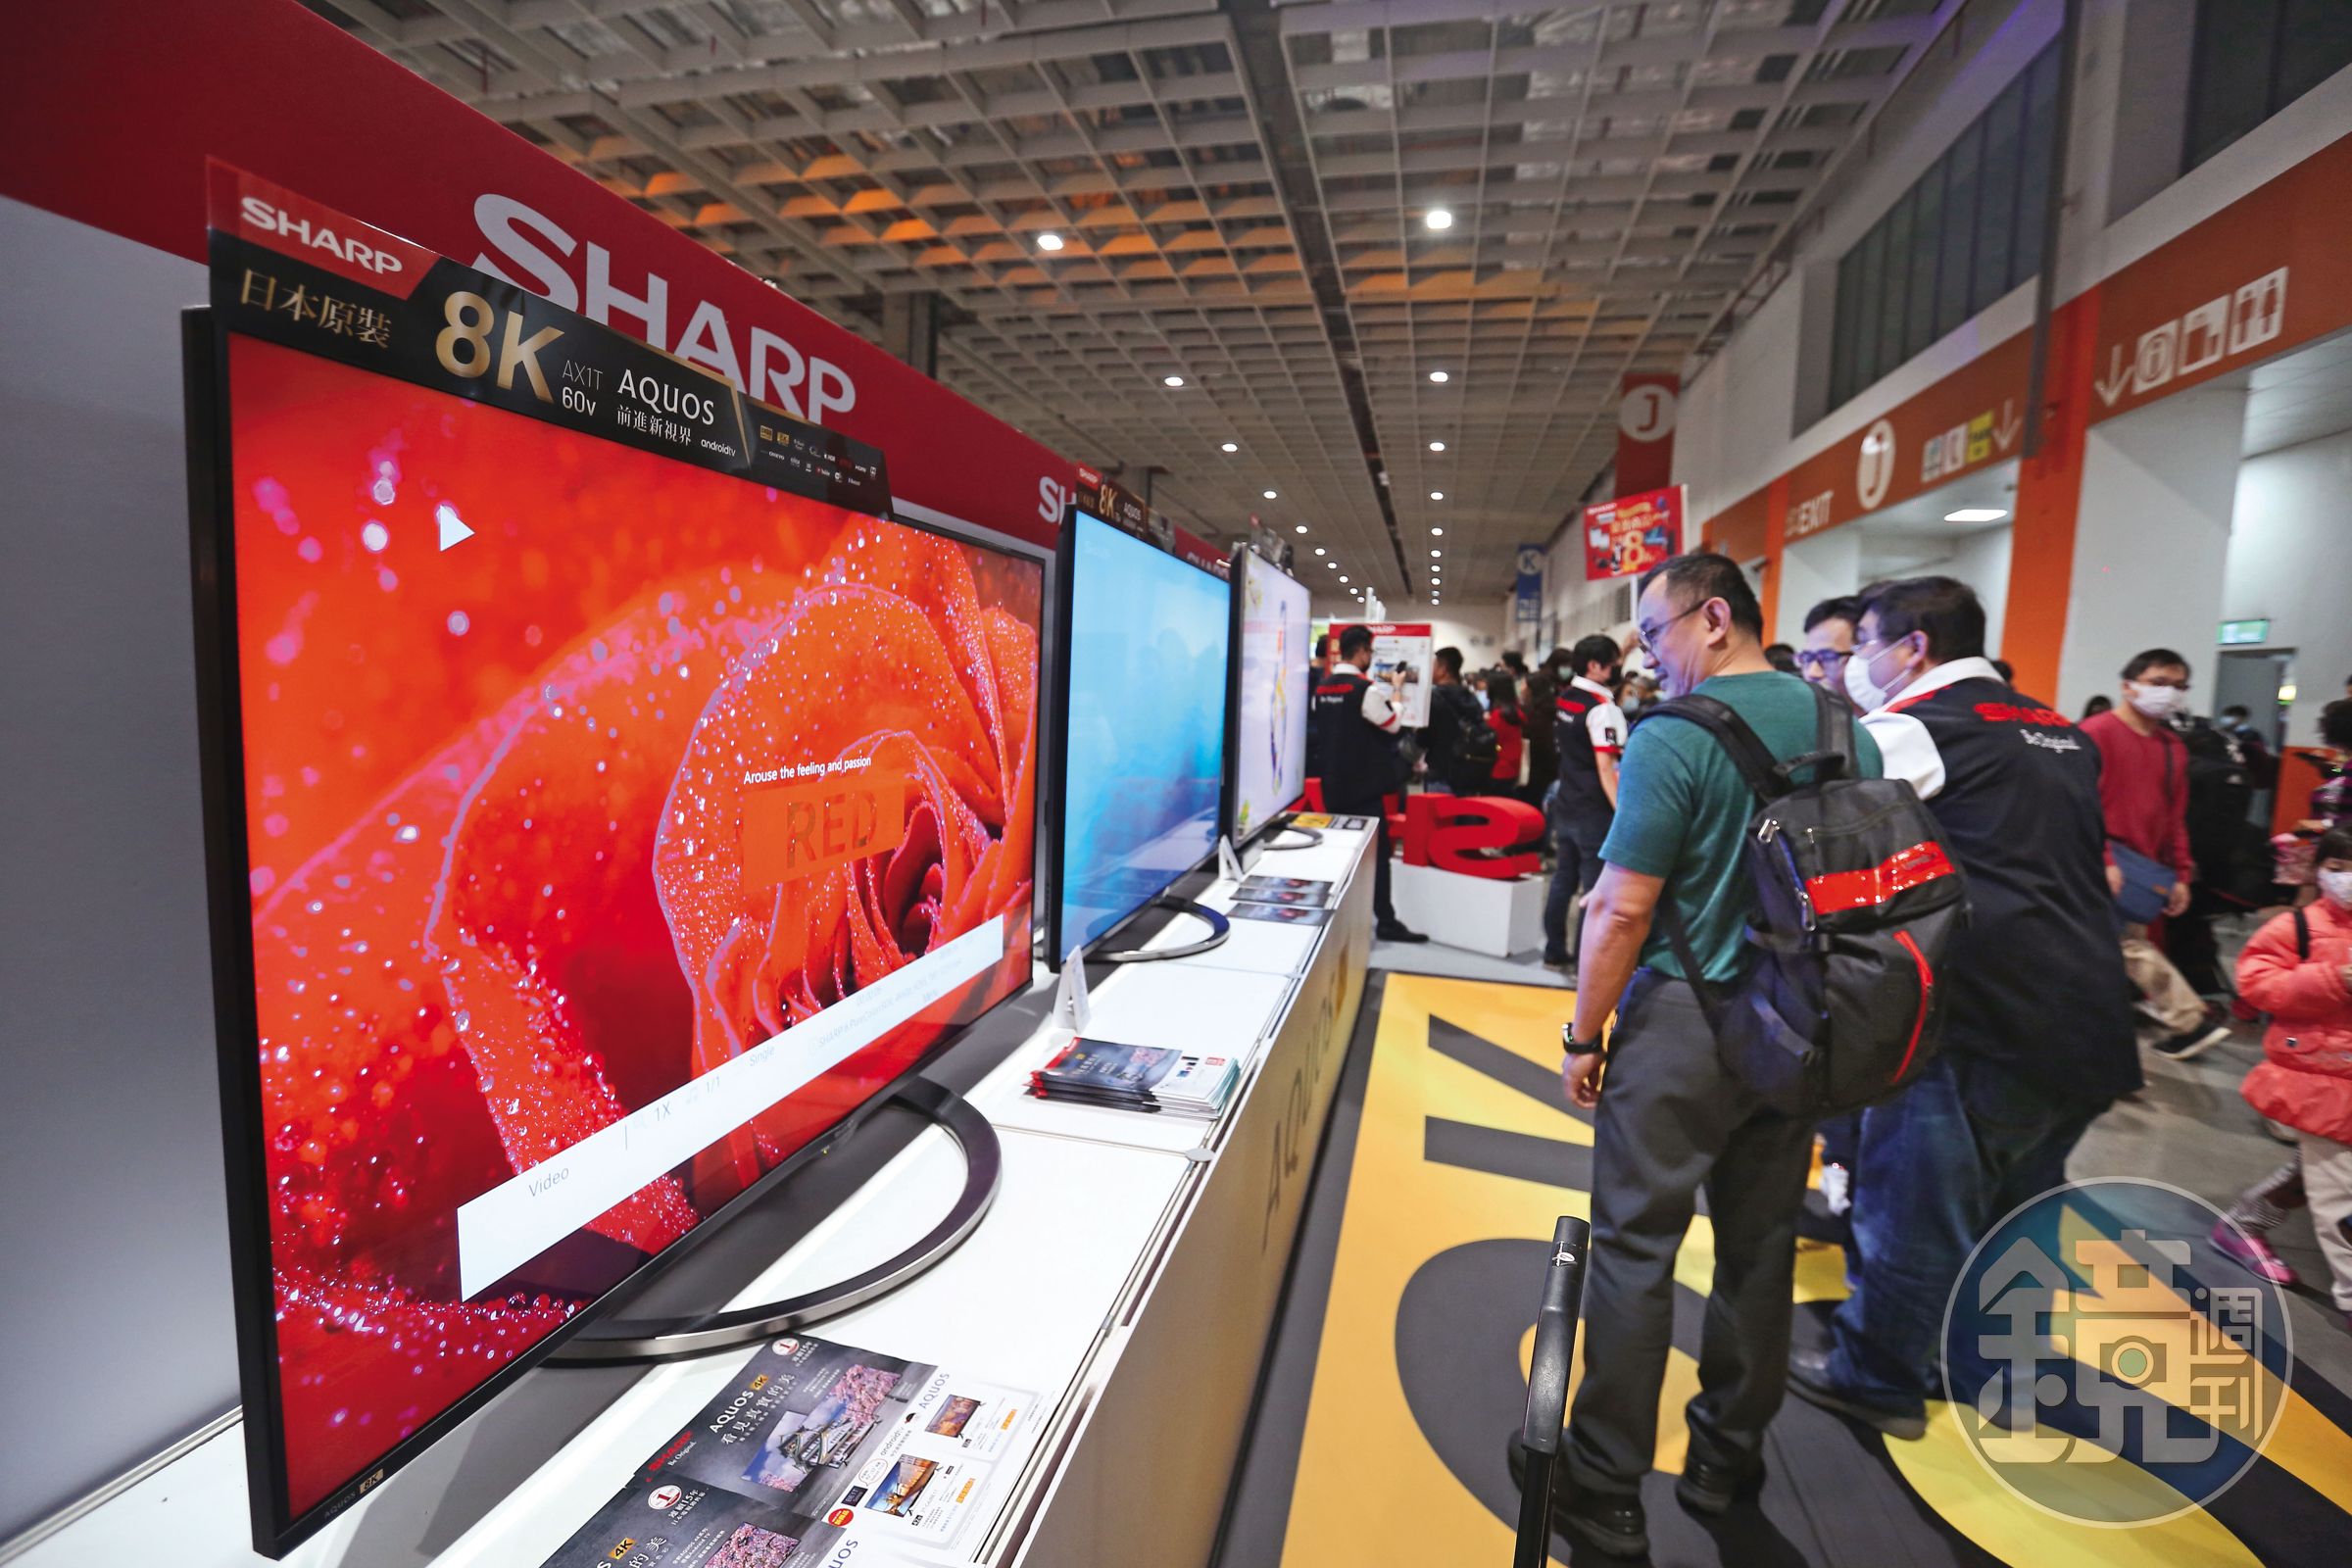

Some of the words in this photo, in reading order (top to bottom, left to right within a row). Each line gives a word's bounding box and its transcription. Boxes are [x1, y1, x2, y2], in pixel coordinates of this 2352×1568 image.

[240, 196, 403, 274] SHARP
[240, 269, 392, 349] 日本原裝
[473, 193, 855, 425] SHARP
[436, 291, 565, 404] 8K
[562, 386, 596, 416] 60v
[617, 368, 714, 425] AQUOS
[1636, 393, 1659, 432] J
[617, 403, 691, 447] 前進新視界
[1100, 483, 1118, 518] 8K
[744, 769, 777, 785] Arouse
[780, 764, 795, 778] the
[797, 761, 825, 777] feeling
[827, 759, 843, 772] and
[844, 755, 871, 773] passion
[786, 790, 878, 869] RED
[749, 1045, 776, 1068] Single
[654, 1101, 672, 1123] 1X
[528, 1166, 570, 1199] Video
[919, 1373, 951, 1409] AQUOS
[709, 1390, 755, 1434] AQUOS
[323, 1491, 357, 1518] AQUOS
